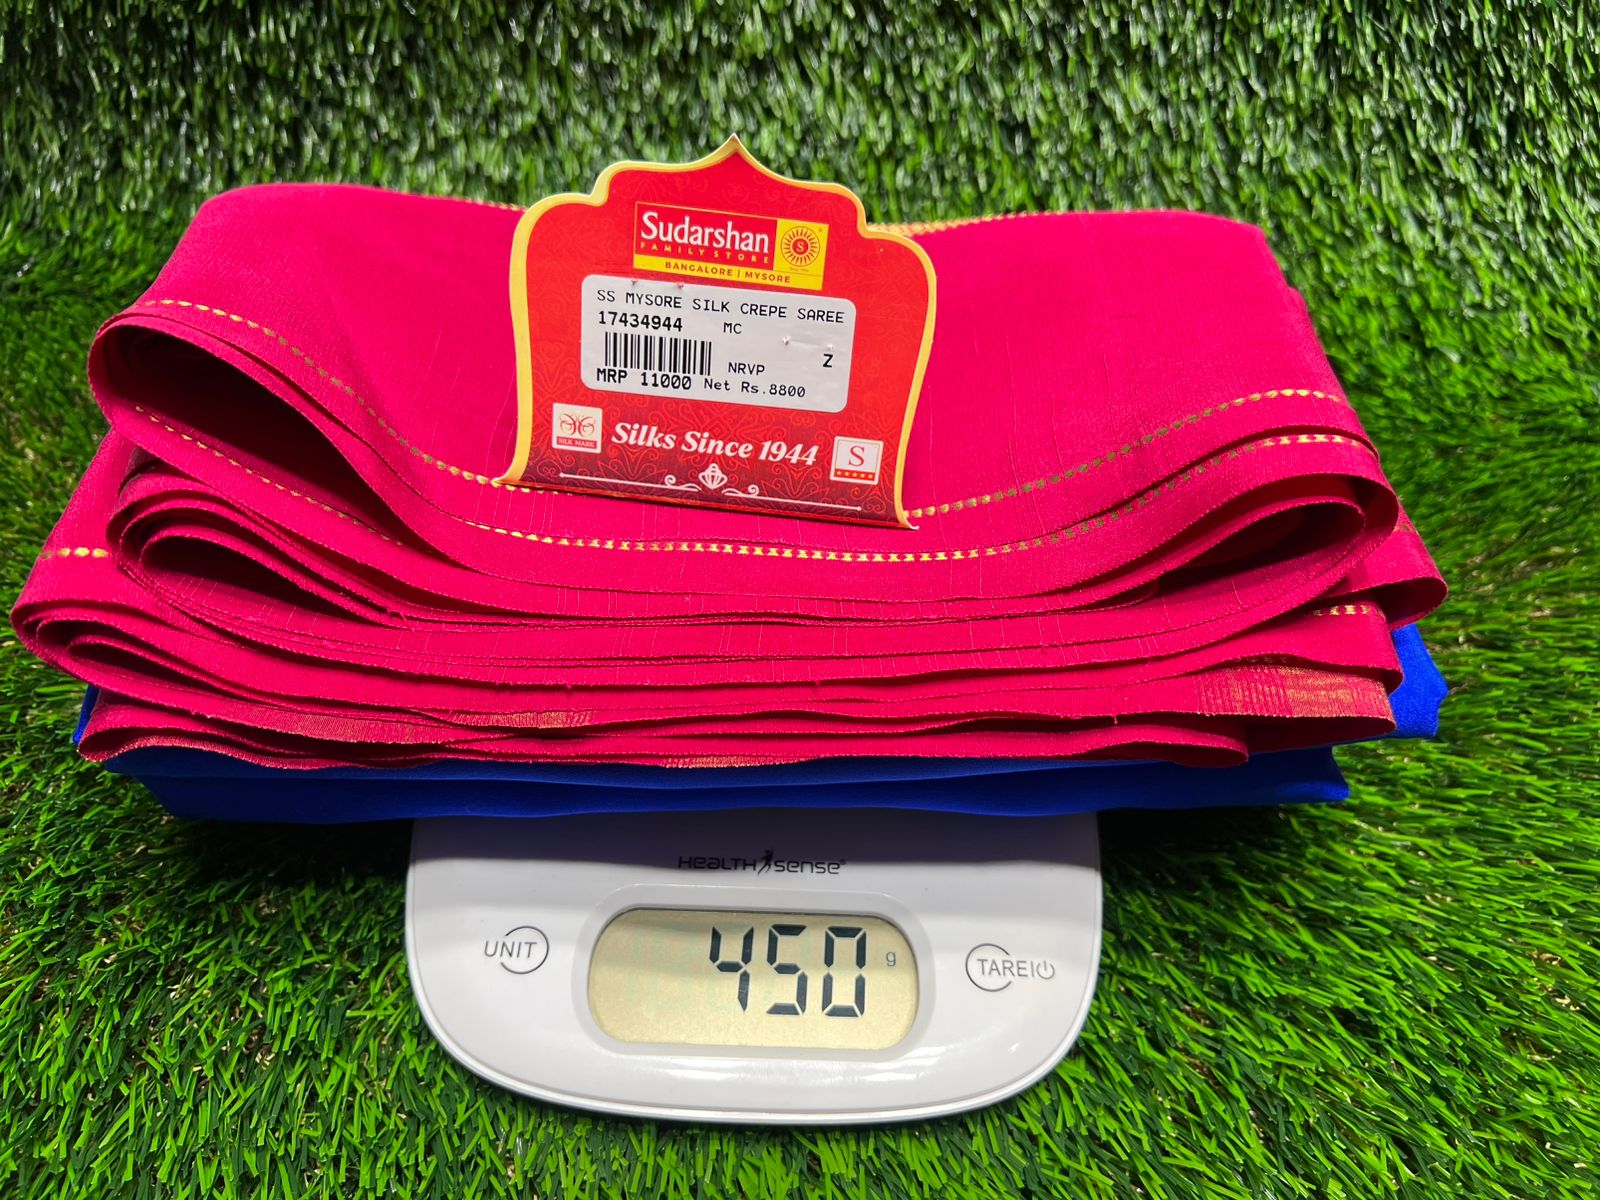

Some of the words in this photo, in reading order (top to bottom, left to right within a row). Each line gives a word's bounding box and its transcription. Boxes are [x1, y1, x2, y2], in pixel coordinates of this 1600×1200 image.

[641, 211, 769, 254] Sudarshan
[640, 242, 705, 256] FAMILY
[713, 251, 769, 264] STORE
[665, 261, 733, 277] BANGALORE
[745, 271, 791, 284] MYSORE
[597, 289, 615, 302] SS
[625, 292, 682, 309] MYSORE
[692, 298, 730, 313] SILK
[740, 303, 787, 318] CREPE
[797, 308, 845, 323] SAREE
[598, 310, 683, 332] 17434944
[723, 322, 742, 334] MC
[728, 361, 765, 376] NRVP
[823, 353, 834, 368] Z
[596, 367, 628, 384] MRP
[640, 372, 692, 390] 11000
[703, 378, 731, 392] Net
[741, 381, 806, 398] Rs.8800
[611, 422, 676, 449] Silks
[681, 431, 753, 459] Since
[758, 440, 819, 465] 1944
[848, 445, 865, 466] S
[484, 940, 539, 960] UNIT
[709, 924, 867, 1018] 450
[885, 948, 897, 968] g
